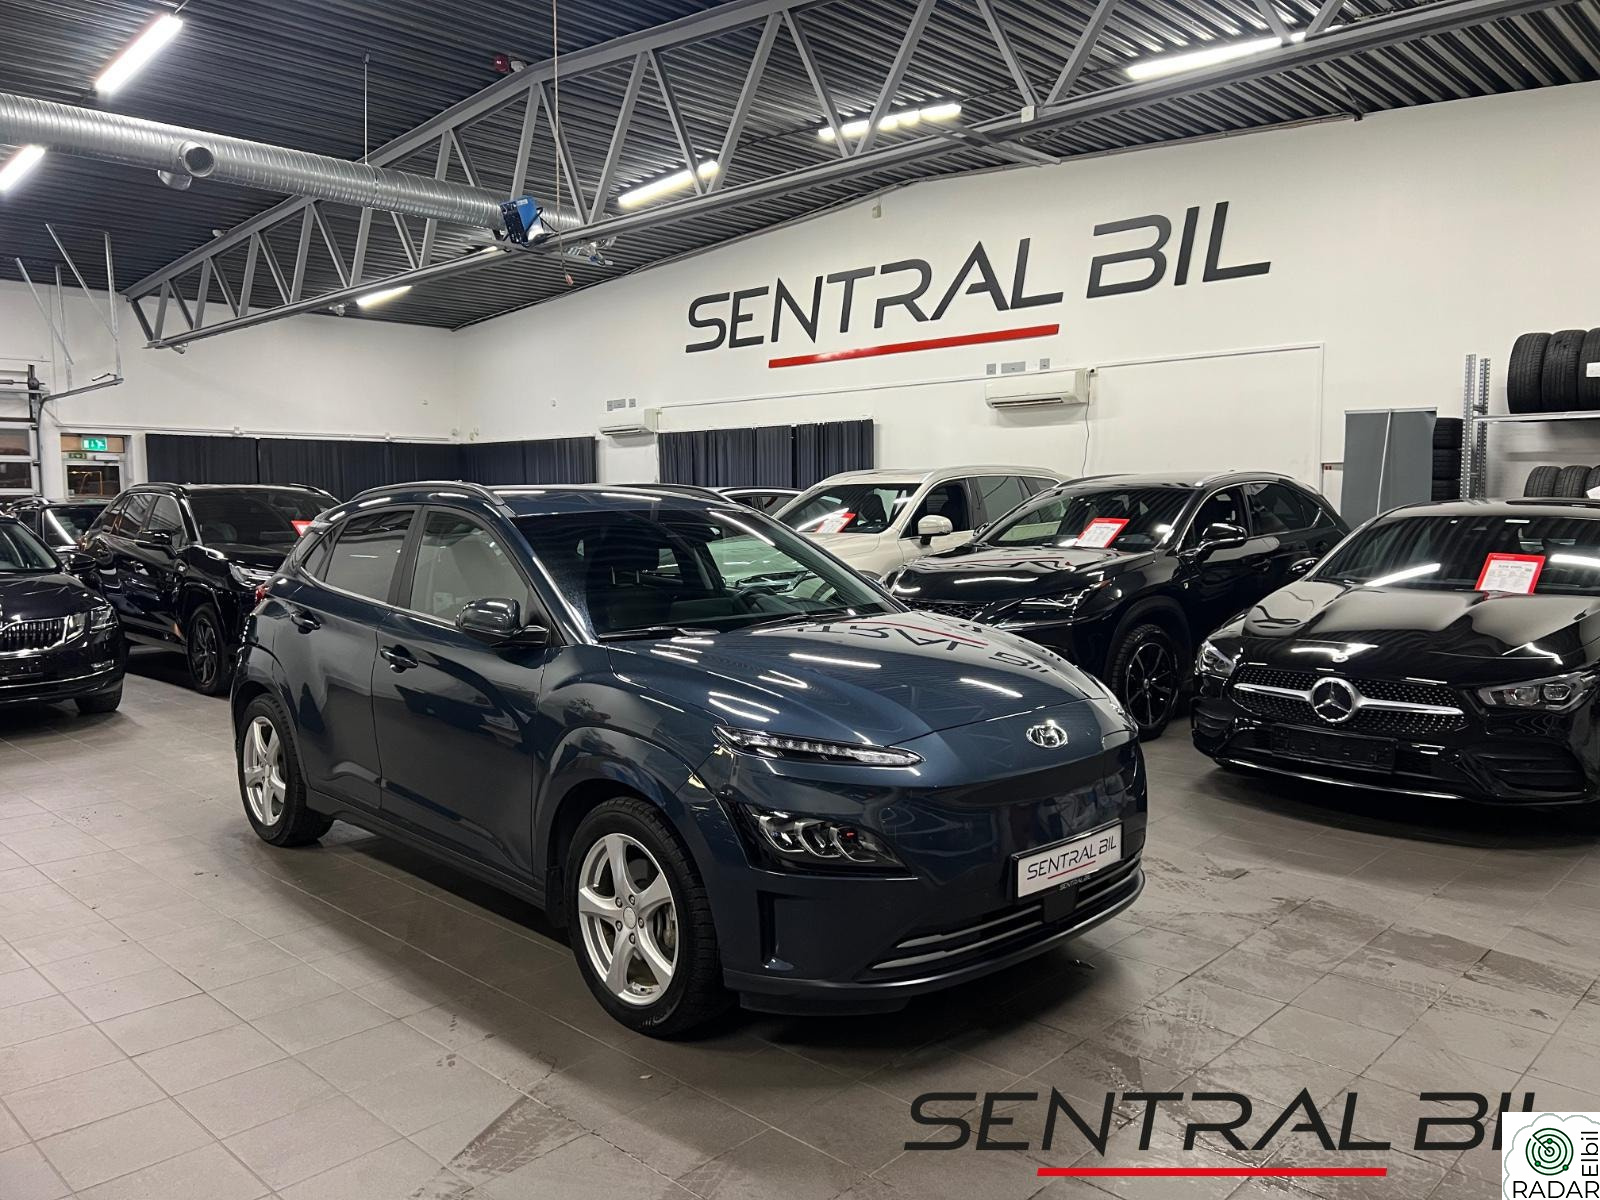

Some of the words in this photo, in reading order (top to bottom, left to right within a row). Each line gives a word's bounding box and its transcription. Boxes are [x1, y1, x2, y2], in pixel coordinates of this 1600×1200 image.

[686, 238, 1063, 353] SENTRAL
[1087, 201, 1271, 299] BIL
[1027, 844, 1096, 880] SENTRAL
[1099, 836, 1116, 854] BIL
